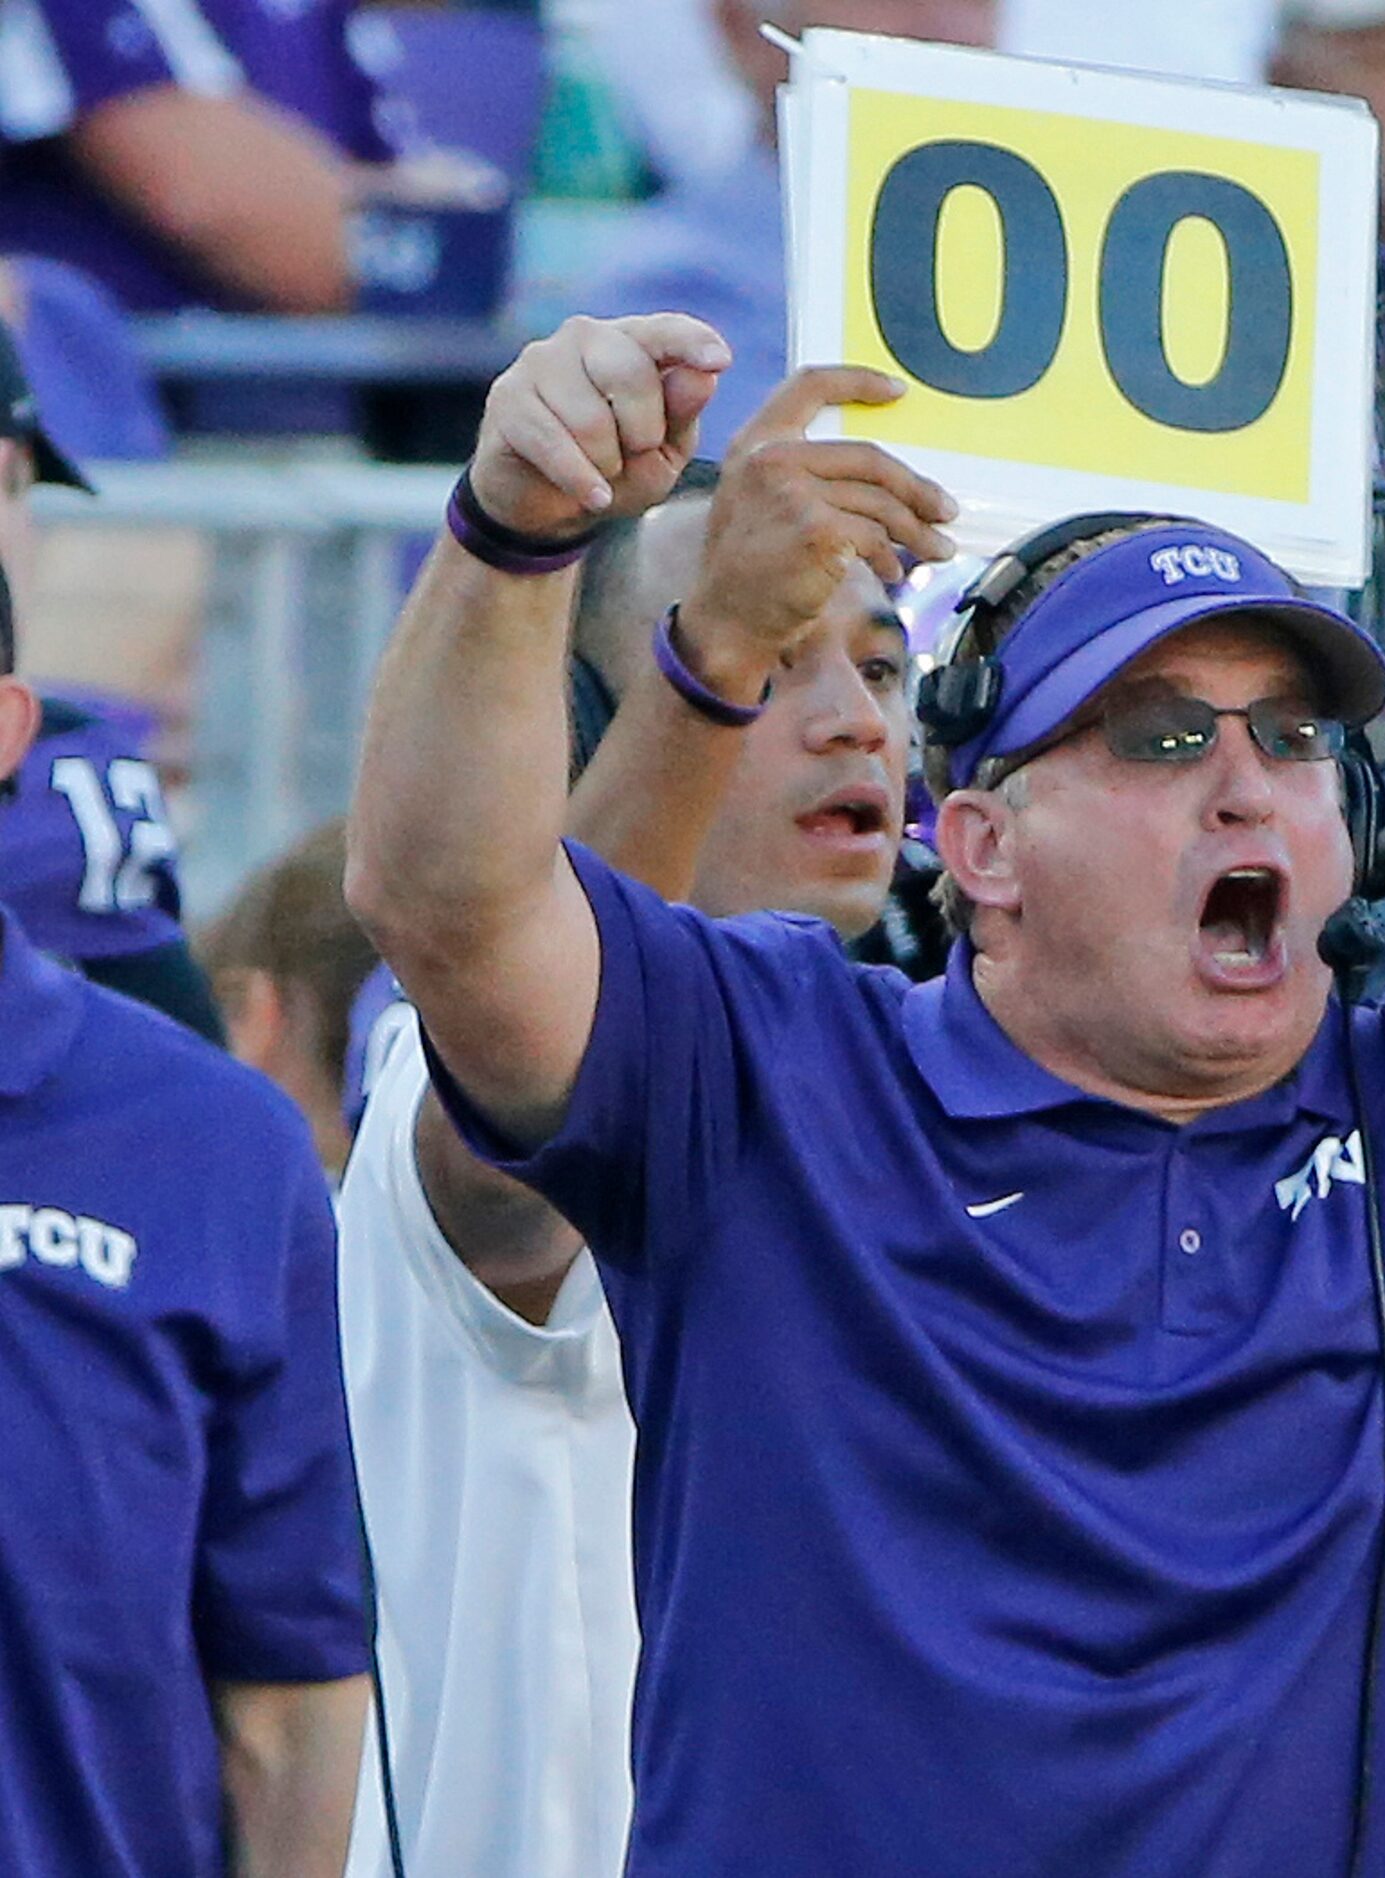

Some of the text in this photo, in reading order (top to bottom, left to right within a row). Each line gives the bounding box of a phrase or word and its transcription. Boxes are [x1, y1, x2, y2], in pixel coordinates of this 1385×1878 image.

[870, 138, 1295, 433] 00
[1149, 544, 1241, 585] TCU
[51, 757, 174, 913] 12
[0, 1202, 139, 1288] TCU
